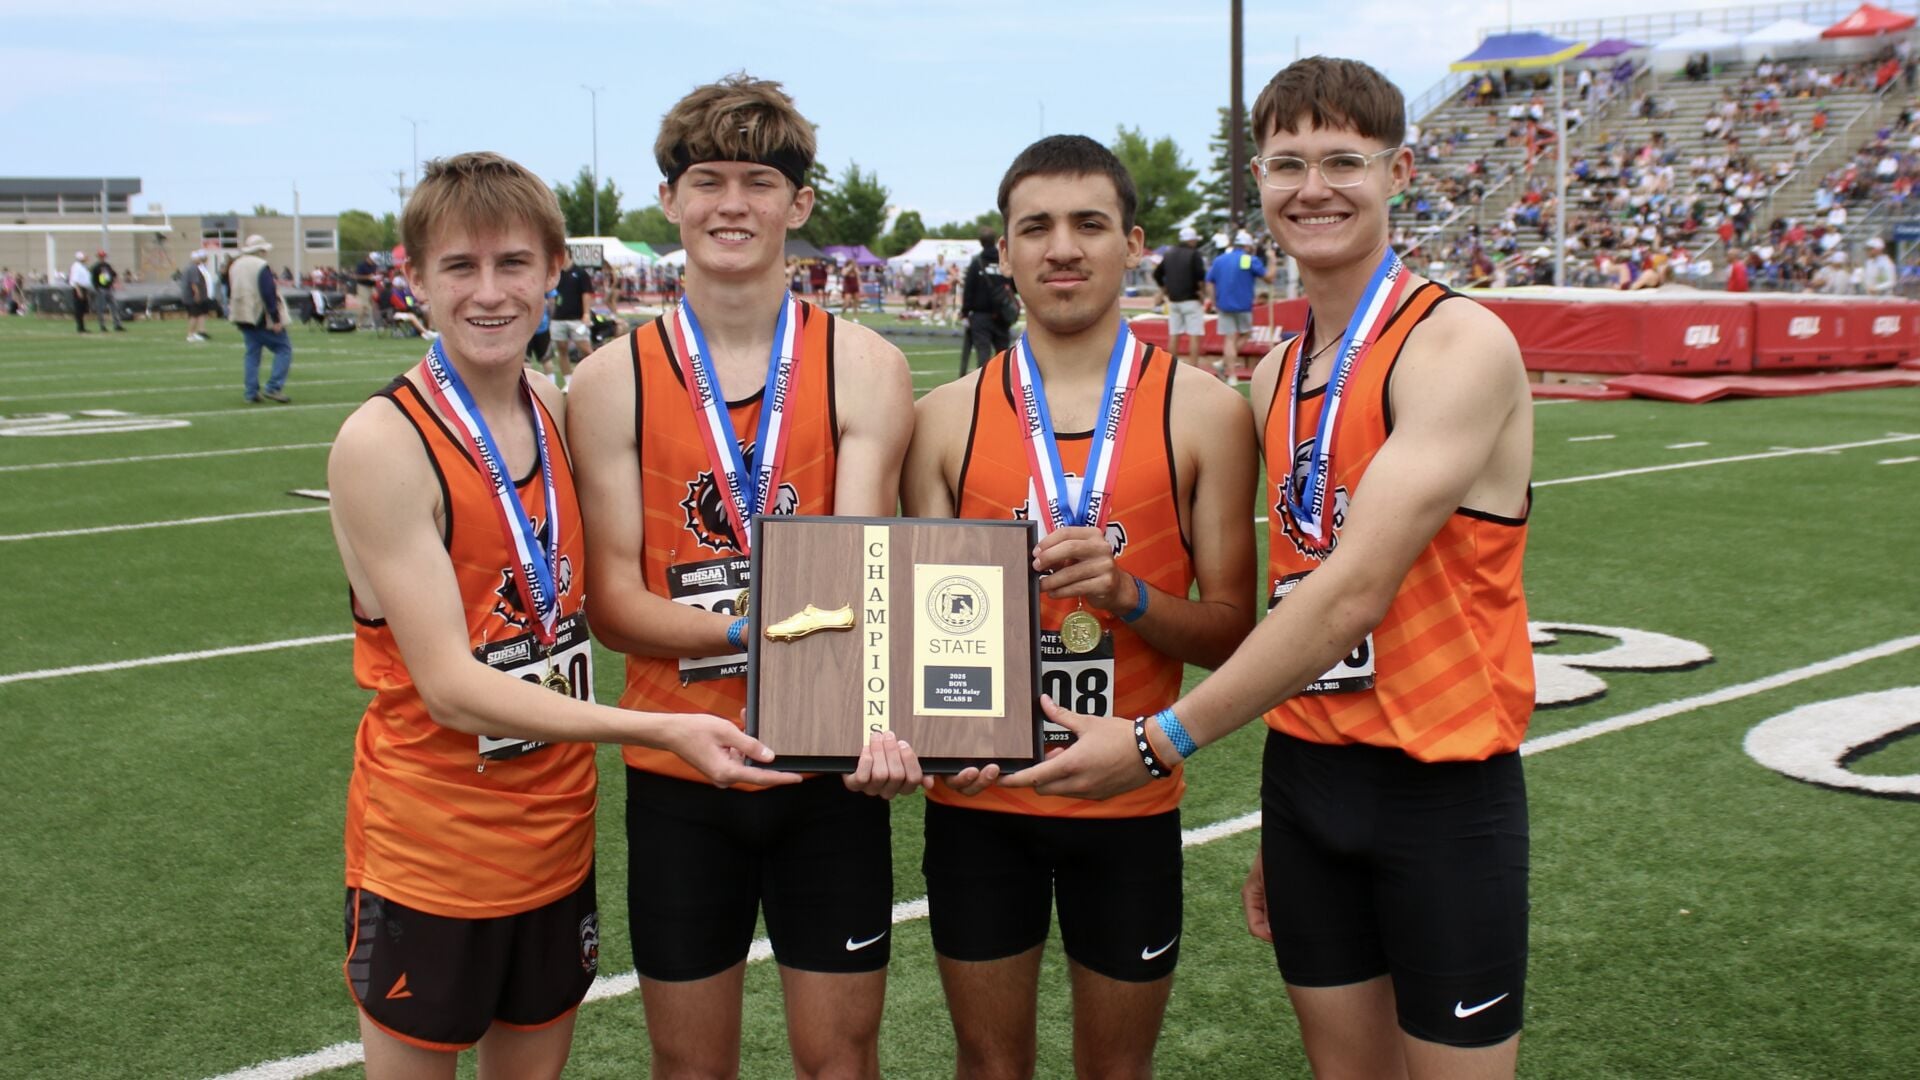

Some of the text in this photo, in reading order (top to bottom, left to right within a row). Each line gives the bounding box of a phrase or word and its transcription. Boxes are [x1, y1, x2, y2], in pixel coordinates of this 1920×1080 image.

[1684, 325, 1720, 347] GILL
[1788, 316, 1821, 337] GILL
[1872, 315, 1901, 335] GILL
[689, 354, 712, 403] SDHSAA
[772, 362, 792, 414] SDHSAA
[1334, 344, 1361, 398] SDHSAA
[1022, 384, 1041, 432] SDHSAA
[1105, 390, 1126, 441] SDHSAA
[473, 436, 505, 489] SDHSAA
[726, 471, 750, 523] SDHSAA
[756, 470, 771, 514] DHSAA
[1311, 458, 1329, 516] SDHSAA
[522, 562, 548, 618] SDHSAA
[681, 561, 750, 584] SDHSAA STAT
[487, 643, 527, 663] SDHSAA
[865, 542, 885, 734] CHAMPIONS
[929, 639, 987, 655] STATE
[720, 666, 738, 675] MAY
[962, 688, 981, 696] Relay
[1050, 733, 1069, 741] 2025
